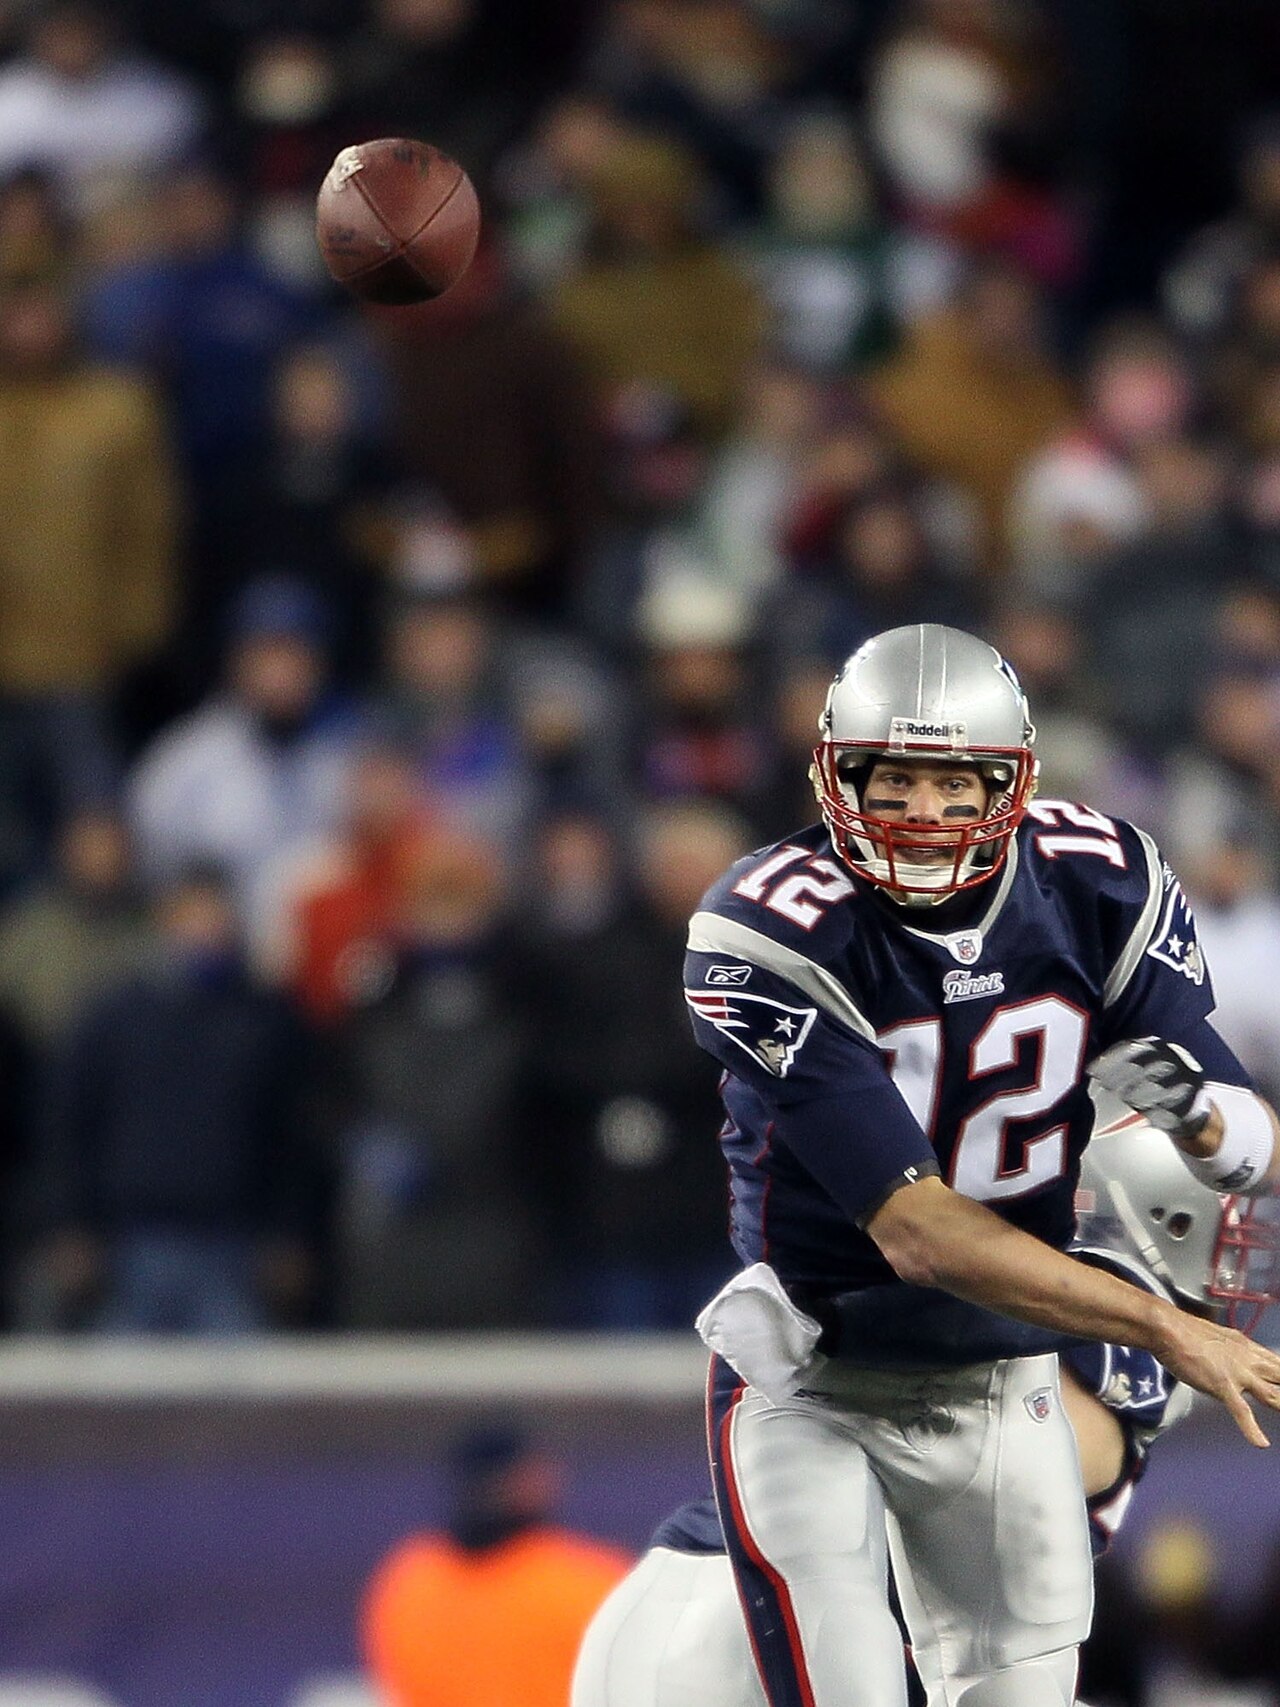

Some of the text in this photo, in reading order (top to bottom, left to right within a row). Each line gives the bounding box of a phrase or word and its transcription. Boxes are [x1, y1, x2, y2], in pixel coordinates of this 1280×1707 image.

[907, 722, 949, 737] Riddell
[1027, 799, 1128, 870] 12
[731, 844, 858, 932] 12
[876, 992, 1091, 1202] 12
